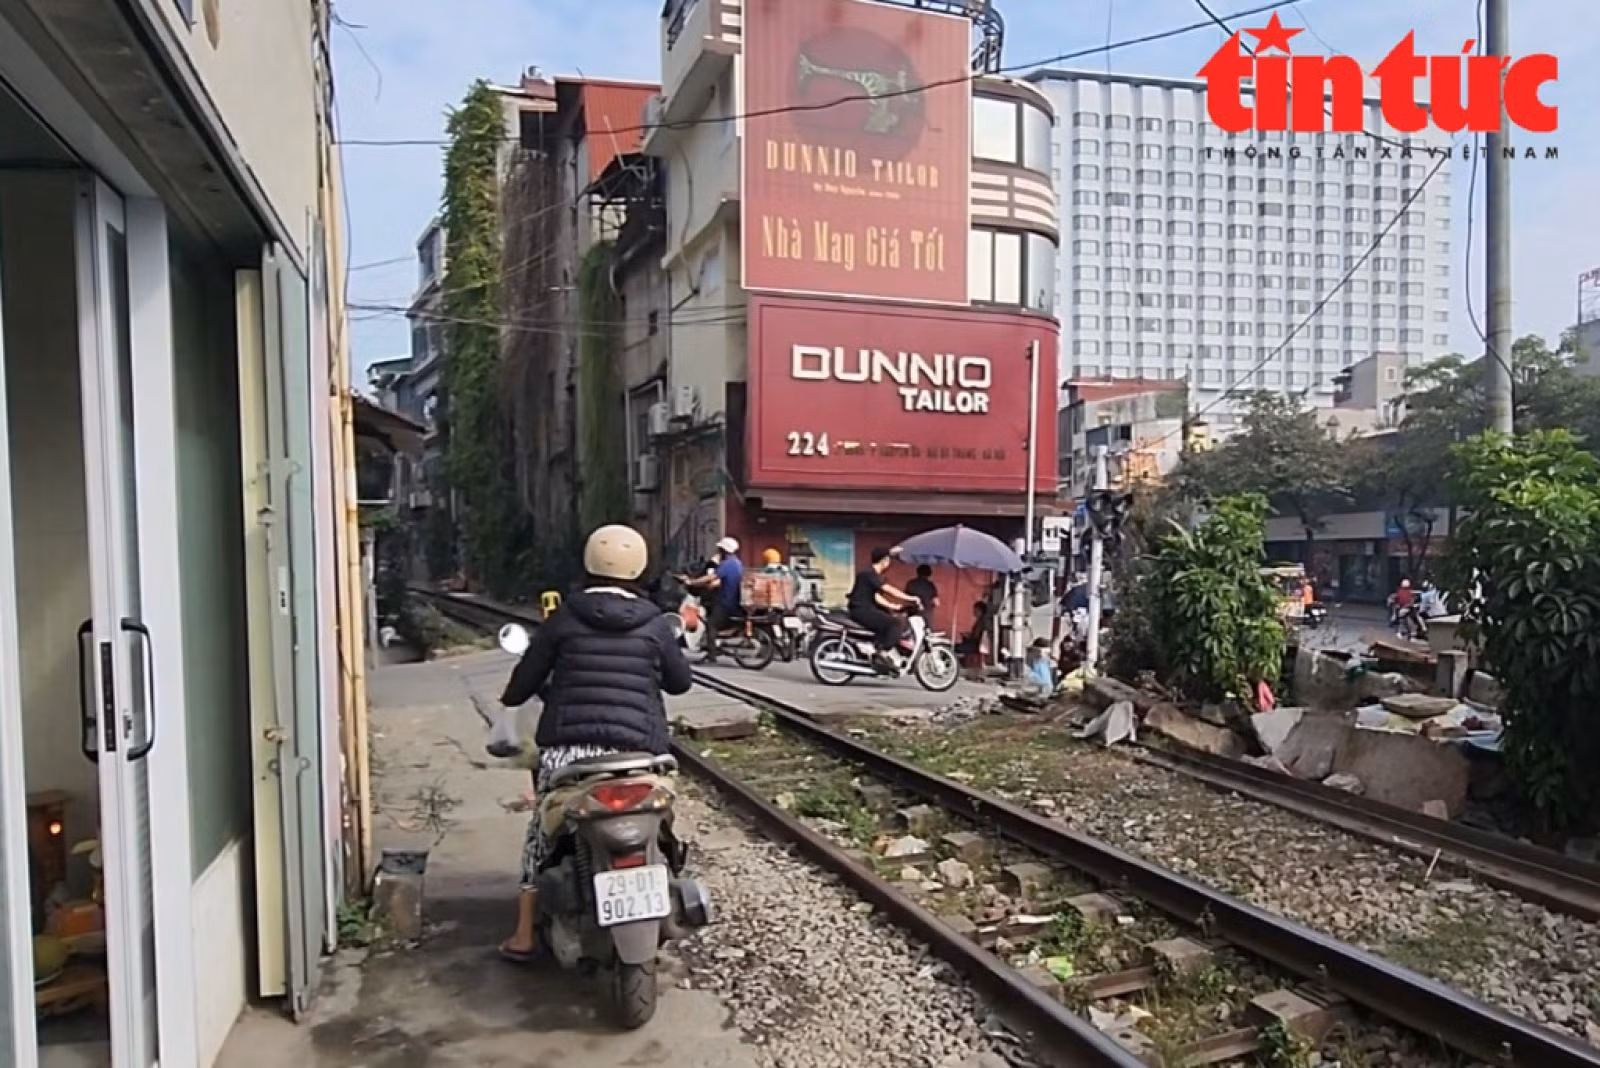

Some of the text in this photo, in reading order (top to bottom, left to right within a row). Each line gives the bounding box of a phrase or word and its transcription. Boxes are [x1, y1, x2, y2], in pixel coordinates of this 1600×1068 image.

[766, 140, 940, 188] DUNNIO TAILOR
[762, 216, 945, 272] Nhà May Giá Tốt
[792, 344, 992, 389] DUNNIO
[898, 387, 990, 414] TAILOR
[786, 431, 829, 456] 224
